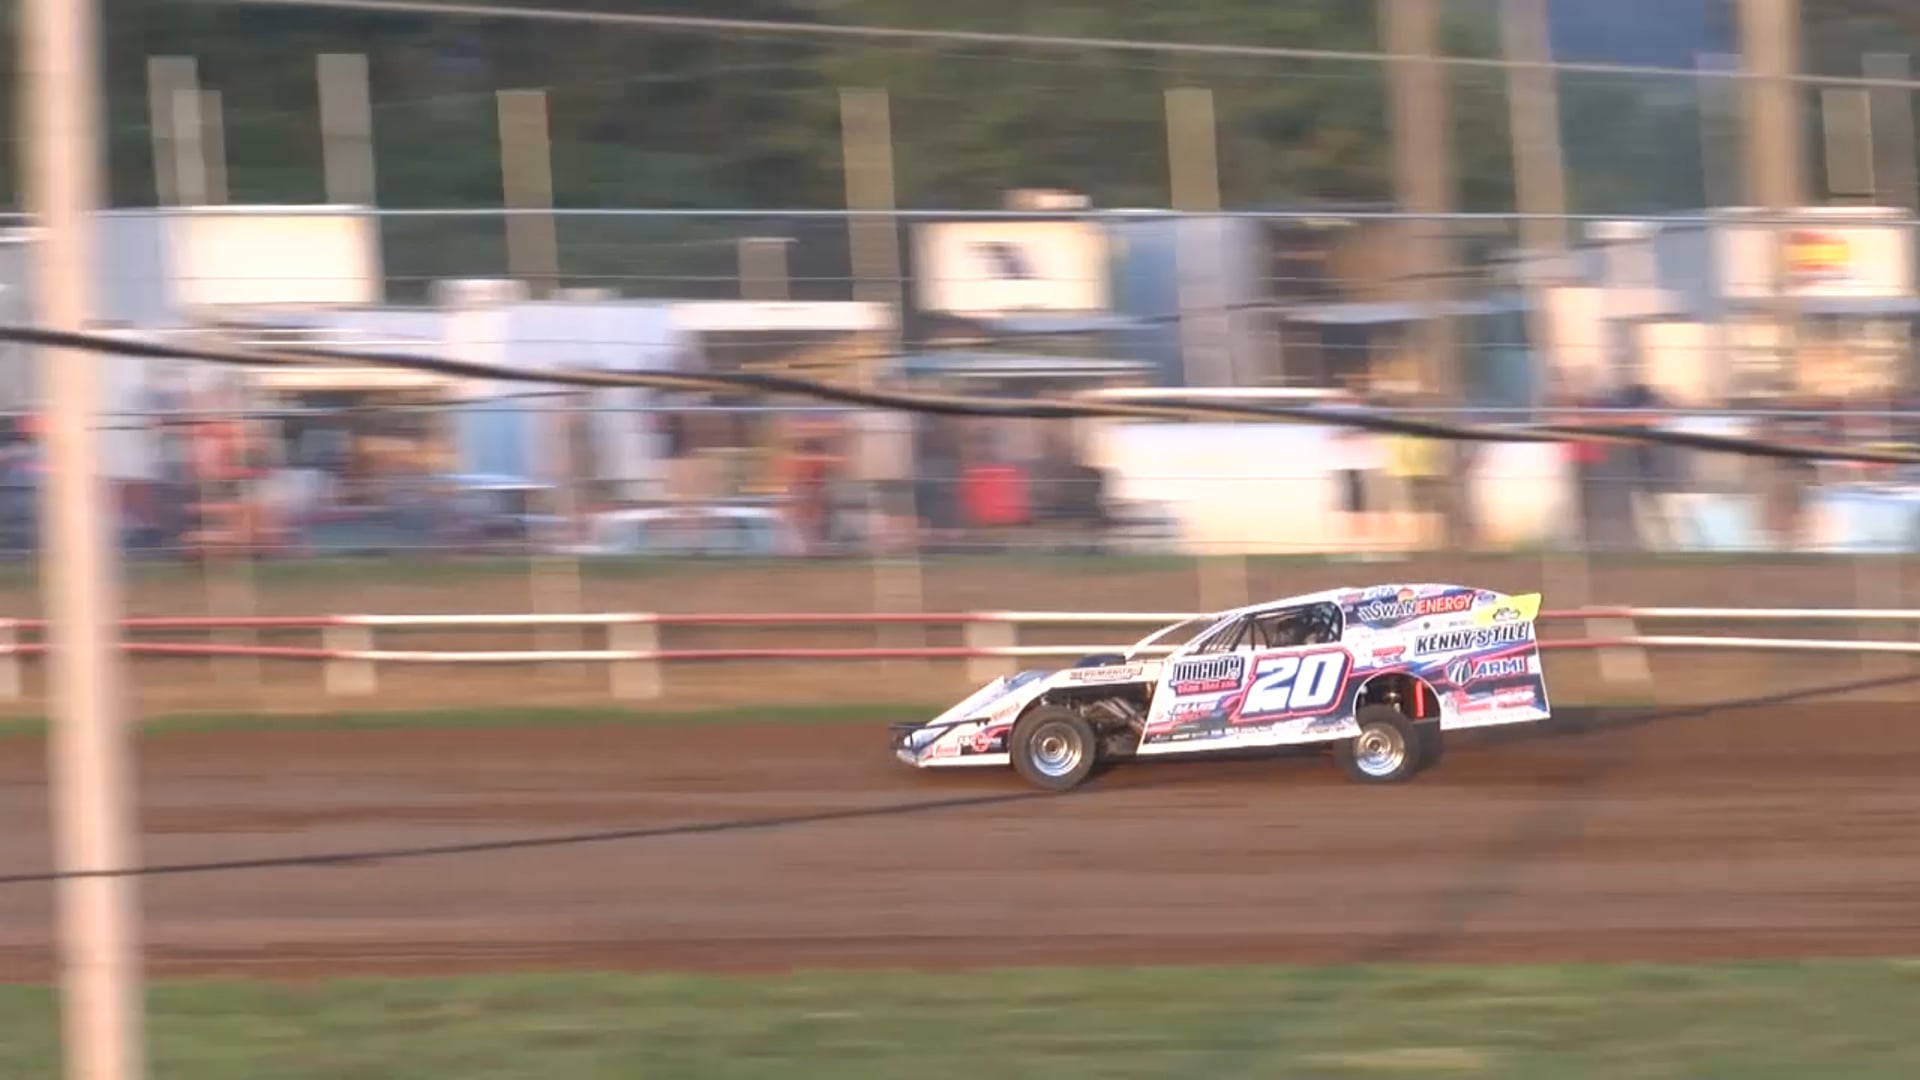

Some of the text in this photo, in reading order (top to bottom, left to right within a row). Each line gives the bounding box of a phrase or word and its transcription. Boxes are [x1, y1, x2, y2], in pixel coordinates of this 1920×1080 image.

[1415, 593, 1473, 615] ENERGY
[1490, 620, 1527, 642] TILE
[1240, 651, 1346, 715] 20
